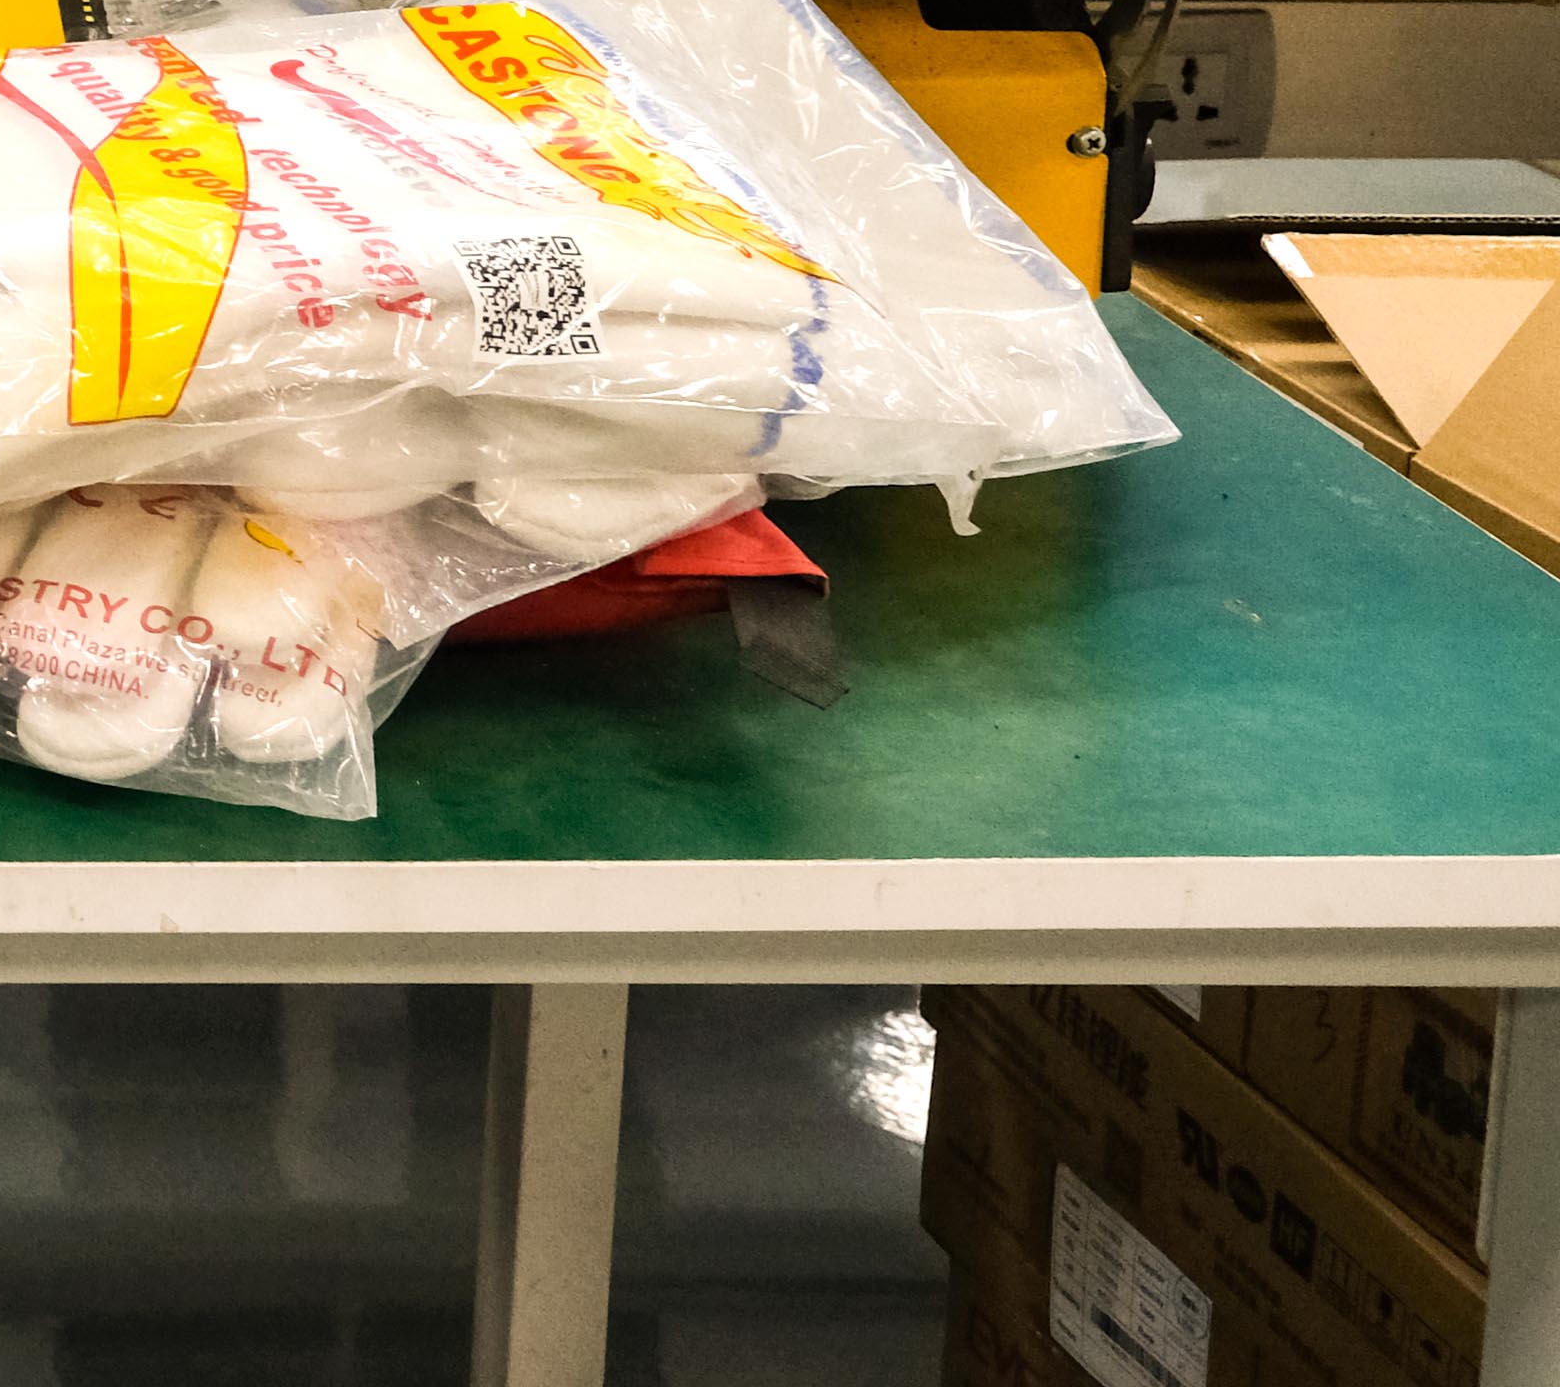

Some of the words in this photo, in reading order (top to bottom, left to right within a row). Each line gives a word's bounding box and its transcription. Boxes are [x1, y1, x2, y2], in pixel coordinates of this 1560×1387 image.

[49, 59, 166, 142] quality
[419, 4, 642, 185] CASTONG
[150, 145, 201, 167] &
[162, 164, 280, 216] good
[231, 221, 337, 329] price
[62, 628, 128, 664] Plaza
[63, 656, 152, 701] CHINA.
[140, 604, 242, 662] CO.,
[260, 634, 349, 697] LTD
